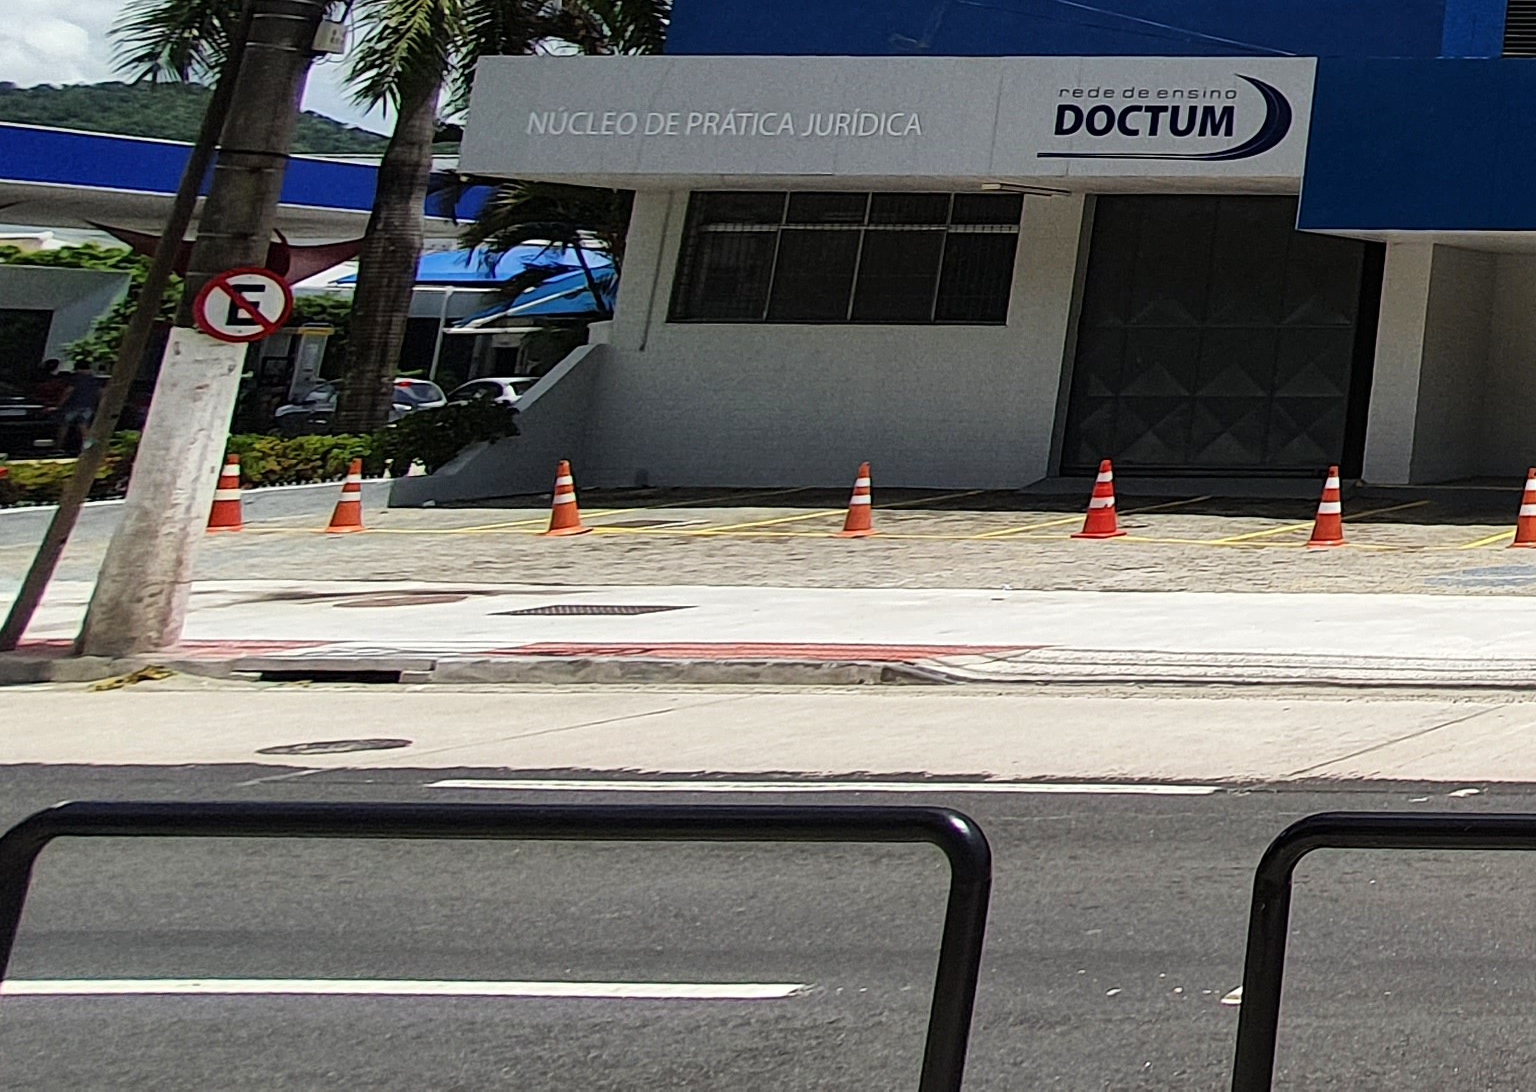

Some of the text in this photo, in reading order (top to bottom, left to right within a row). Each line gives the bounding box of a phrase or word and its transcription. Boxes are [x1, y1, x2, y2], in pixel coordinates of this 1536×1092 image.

[1058, 86, 1238, 100] rede de ensino
[525, 107, 923, 137] NÚCLEO DE PRÁTICA JURÍDICA
[1053, 103, 1236, 138] DOCTUM
[225, 283, 267, 326] E
